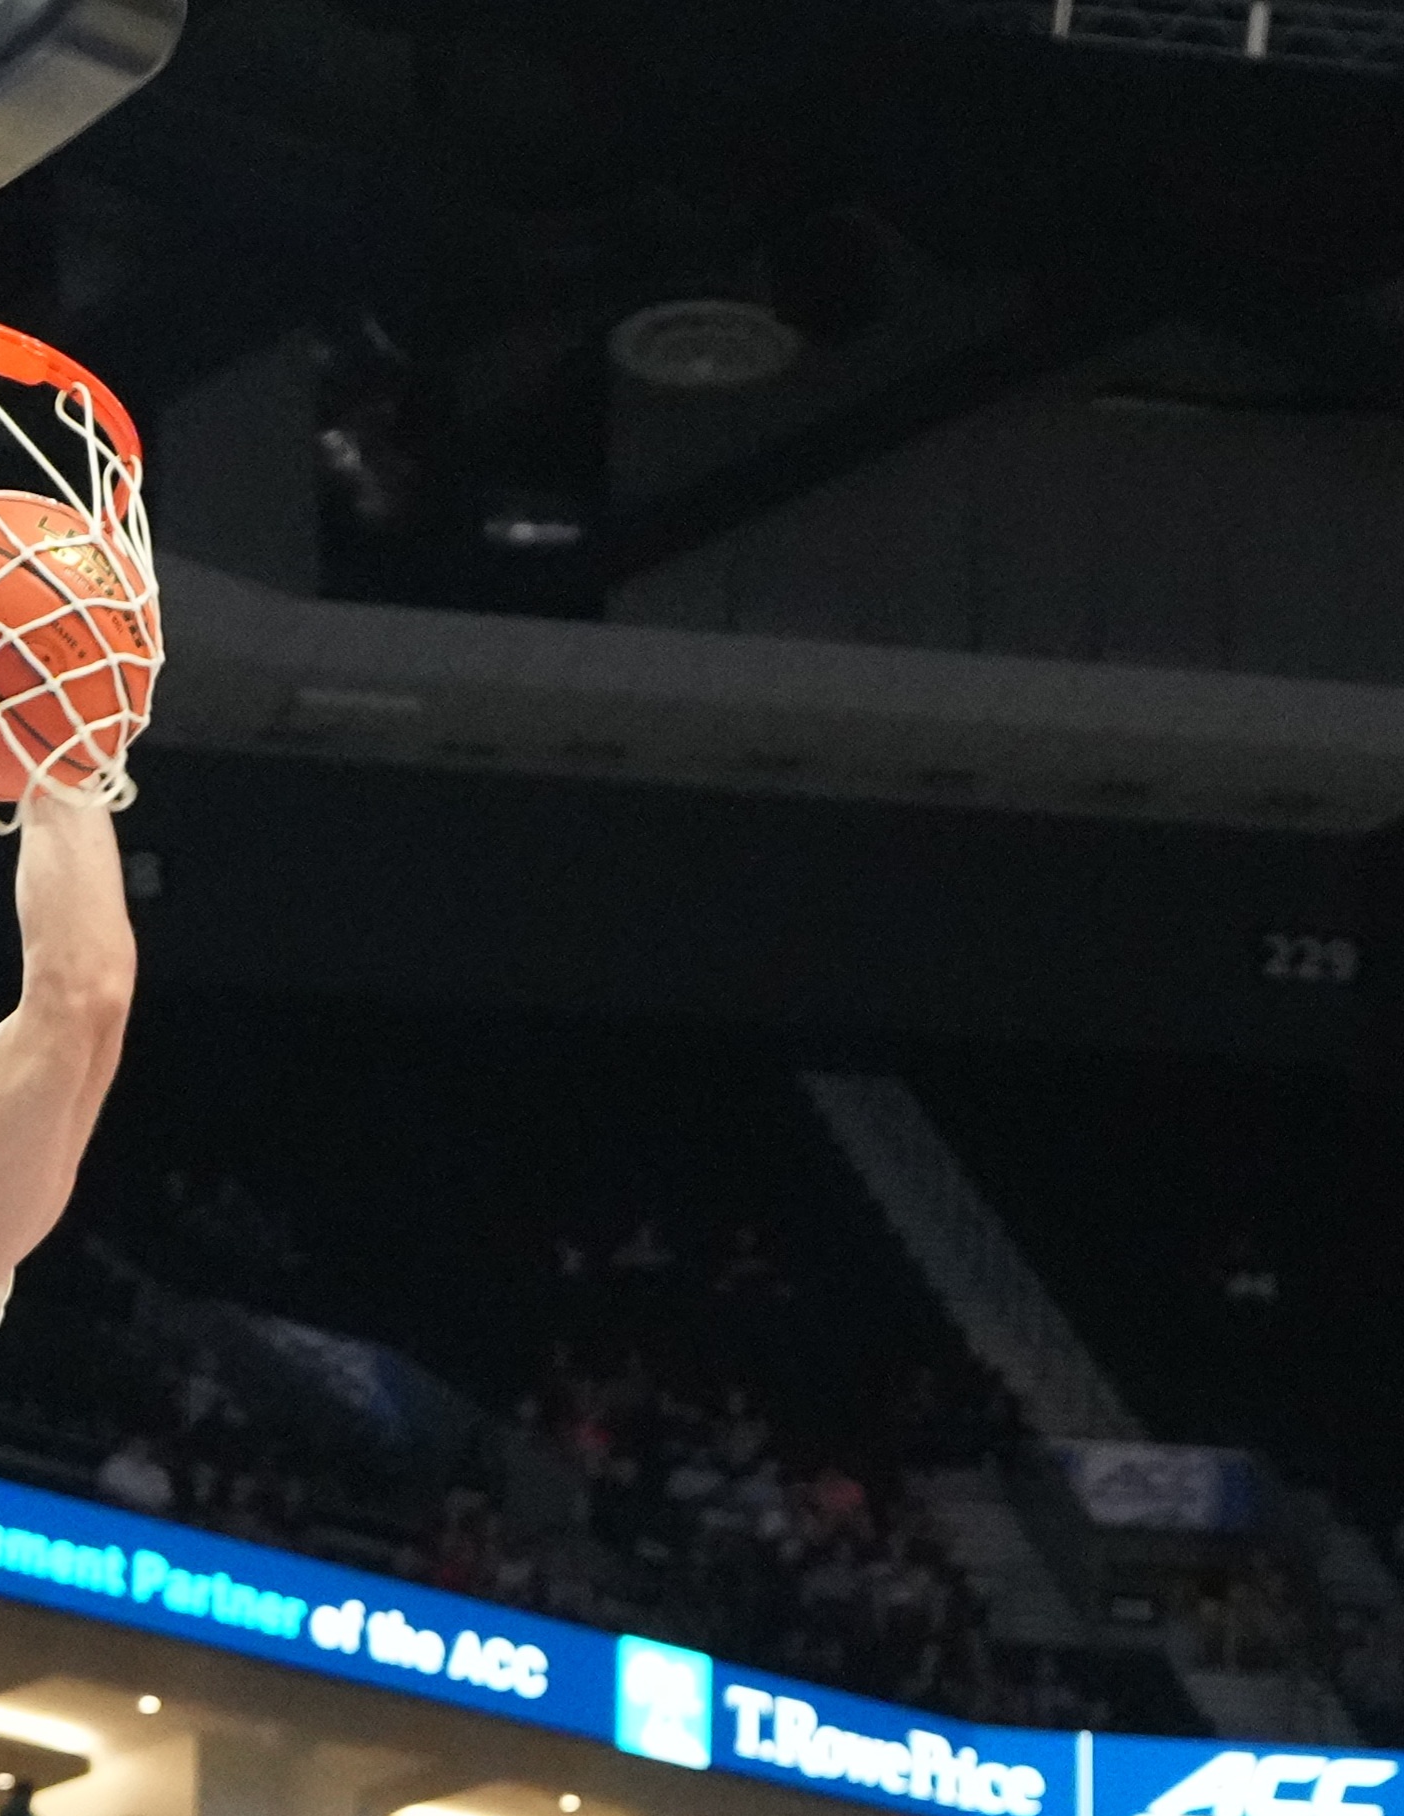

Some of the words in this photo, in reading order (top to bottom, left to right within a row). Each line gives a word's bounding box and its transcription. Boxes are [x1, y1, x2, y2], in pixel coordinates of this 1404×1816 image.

[132, 1549, 308, 1639] Partner
[308, 1598, 366, 1655] of
[366, 1609, 446, 1675] the
[446, 1629, 549, 1700] ACC
